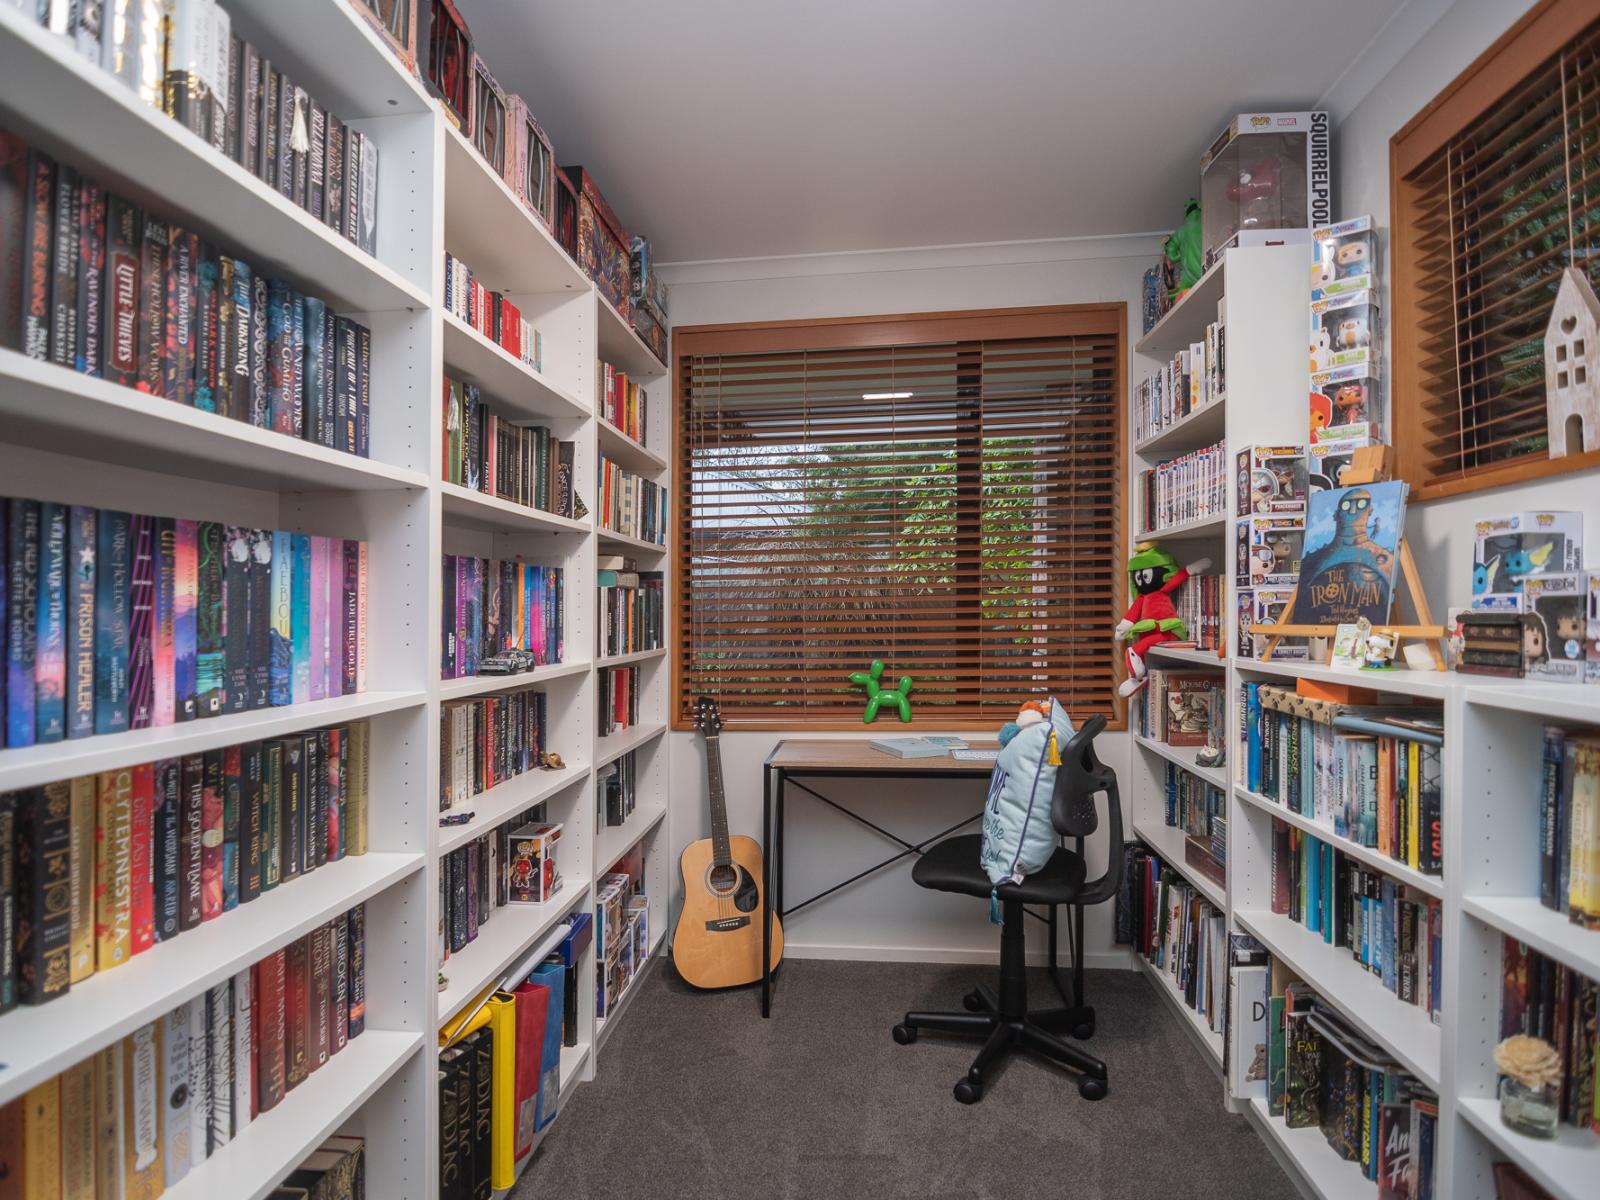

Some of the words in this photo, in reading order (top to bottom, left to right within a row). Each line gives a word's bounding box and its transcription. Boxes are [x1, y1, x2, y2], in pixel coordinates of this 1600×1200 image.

[312, 108, 325, 184] BELLADONNA
[1311, 112, 1328, 229] SQUIRRELPOOL
[60, 184, 71, 232] FLOWER
[350, 213, 358, 238] DARK
[57, 236, 70, 275] BRIDE
[179, 255, 189, 283] RIVER
[86, 267, 100, 333] RAVENOUS
[118, 263, 136, 304] LITTLE
[178, 285, 190, 344] ENCHANTED
[282, 303, 293, 333] GOD
[118, 310, 137, 362] THIEVES
[236, 304, 251, 377] DARKENING
[327, 316, 336, 366] IMMORTAL
[346, 330, 357, 371] PORTRAIT
[150, 342, 162, 382] VOWS
[281, 347, 294, 401] GUMIHO
[347, 372, 357, 386] OF
[25, 513, 37, 538] THE
[25, 544, 37, 573] RED
[1326, 568, 1345, 583] THE
[11, 560, 21, 600] ALIETTE
[1310, 582, 1350, 609] IRON
[1350, 580, 1382, 608] MAN
[77, 593, 94, 648] PRISON
[348, 592, 356, 618] JADE
[348, 644, 357, 676] GOLD
[76, 652, 94, 712] HEALER
[1240, 690, 1248, 734] CORNWELL
[190, 783, 202, 808] THIS
[1359, 784, 1367, 816] BROWN
[1547, 764, 1557, 803] PATRICK
[133, 798, 146, 827] ONE
[250, 793, 260, 831] WITCH
[1546, 807, 1556, 857] ROBINSON
[133, 835, 146, 868] LAST
[164, 829, 176, 875] WOODSMAN
[187, 811, 201, 860] GOLDEN
[250, 836, 260, 864] KING
[309, 815, 317, 857] VILLAINS
[114, 772, 132, 944] CLYTEMNESTRA
[71, 863, 80, 930] UNDERWOOD
[186, 864, 201, 901] FLAME
[1374, 905, 1384, 947] HENRY
[312, 928, 324, 977] HRONE
[322, 926, 331, 971] ASMINE
[335, 925, 347, 1001] UNBROKEN
[1402, 965, 1412, 1000] ECHOES
[336, 1003, 344, 1034] CLARK
[459, 1061, 471, 1157] ZODIAC
[476, 1044, 492, 1141] ZODIAC
[442, 1079, 460, 1188] ZODIAC
